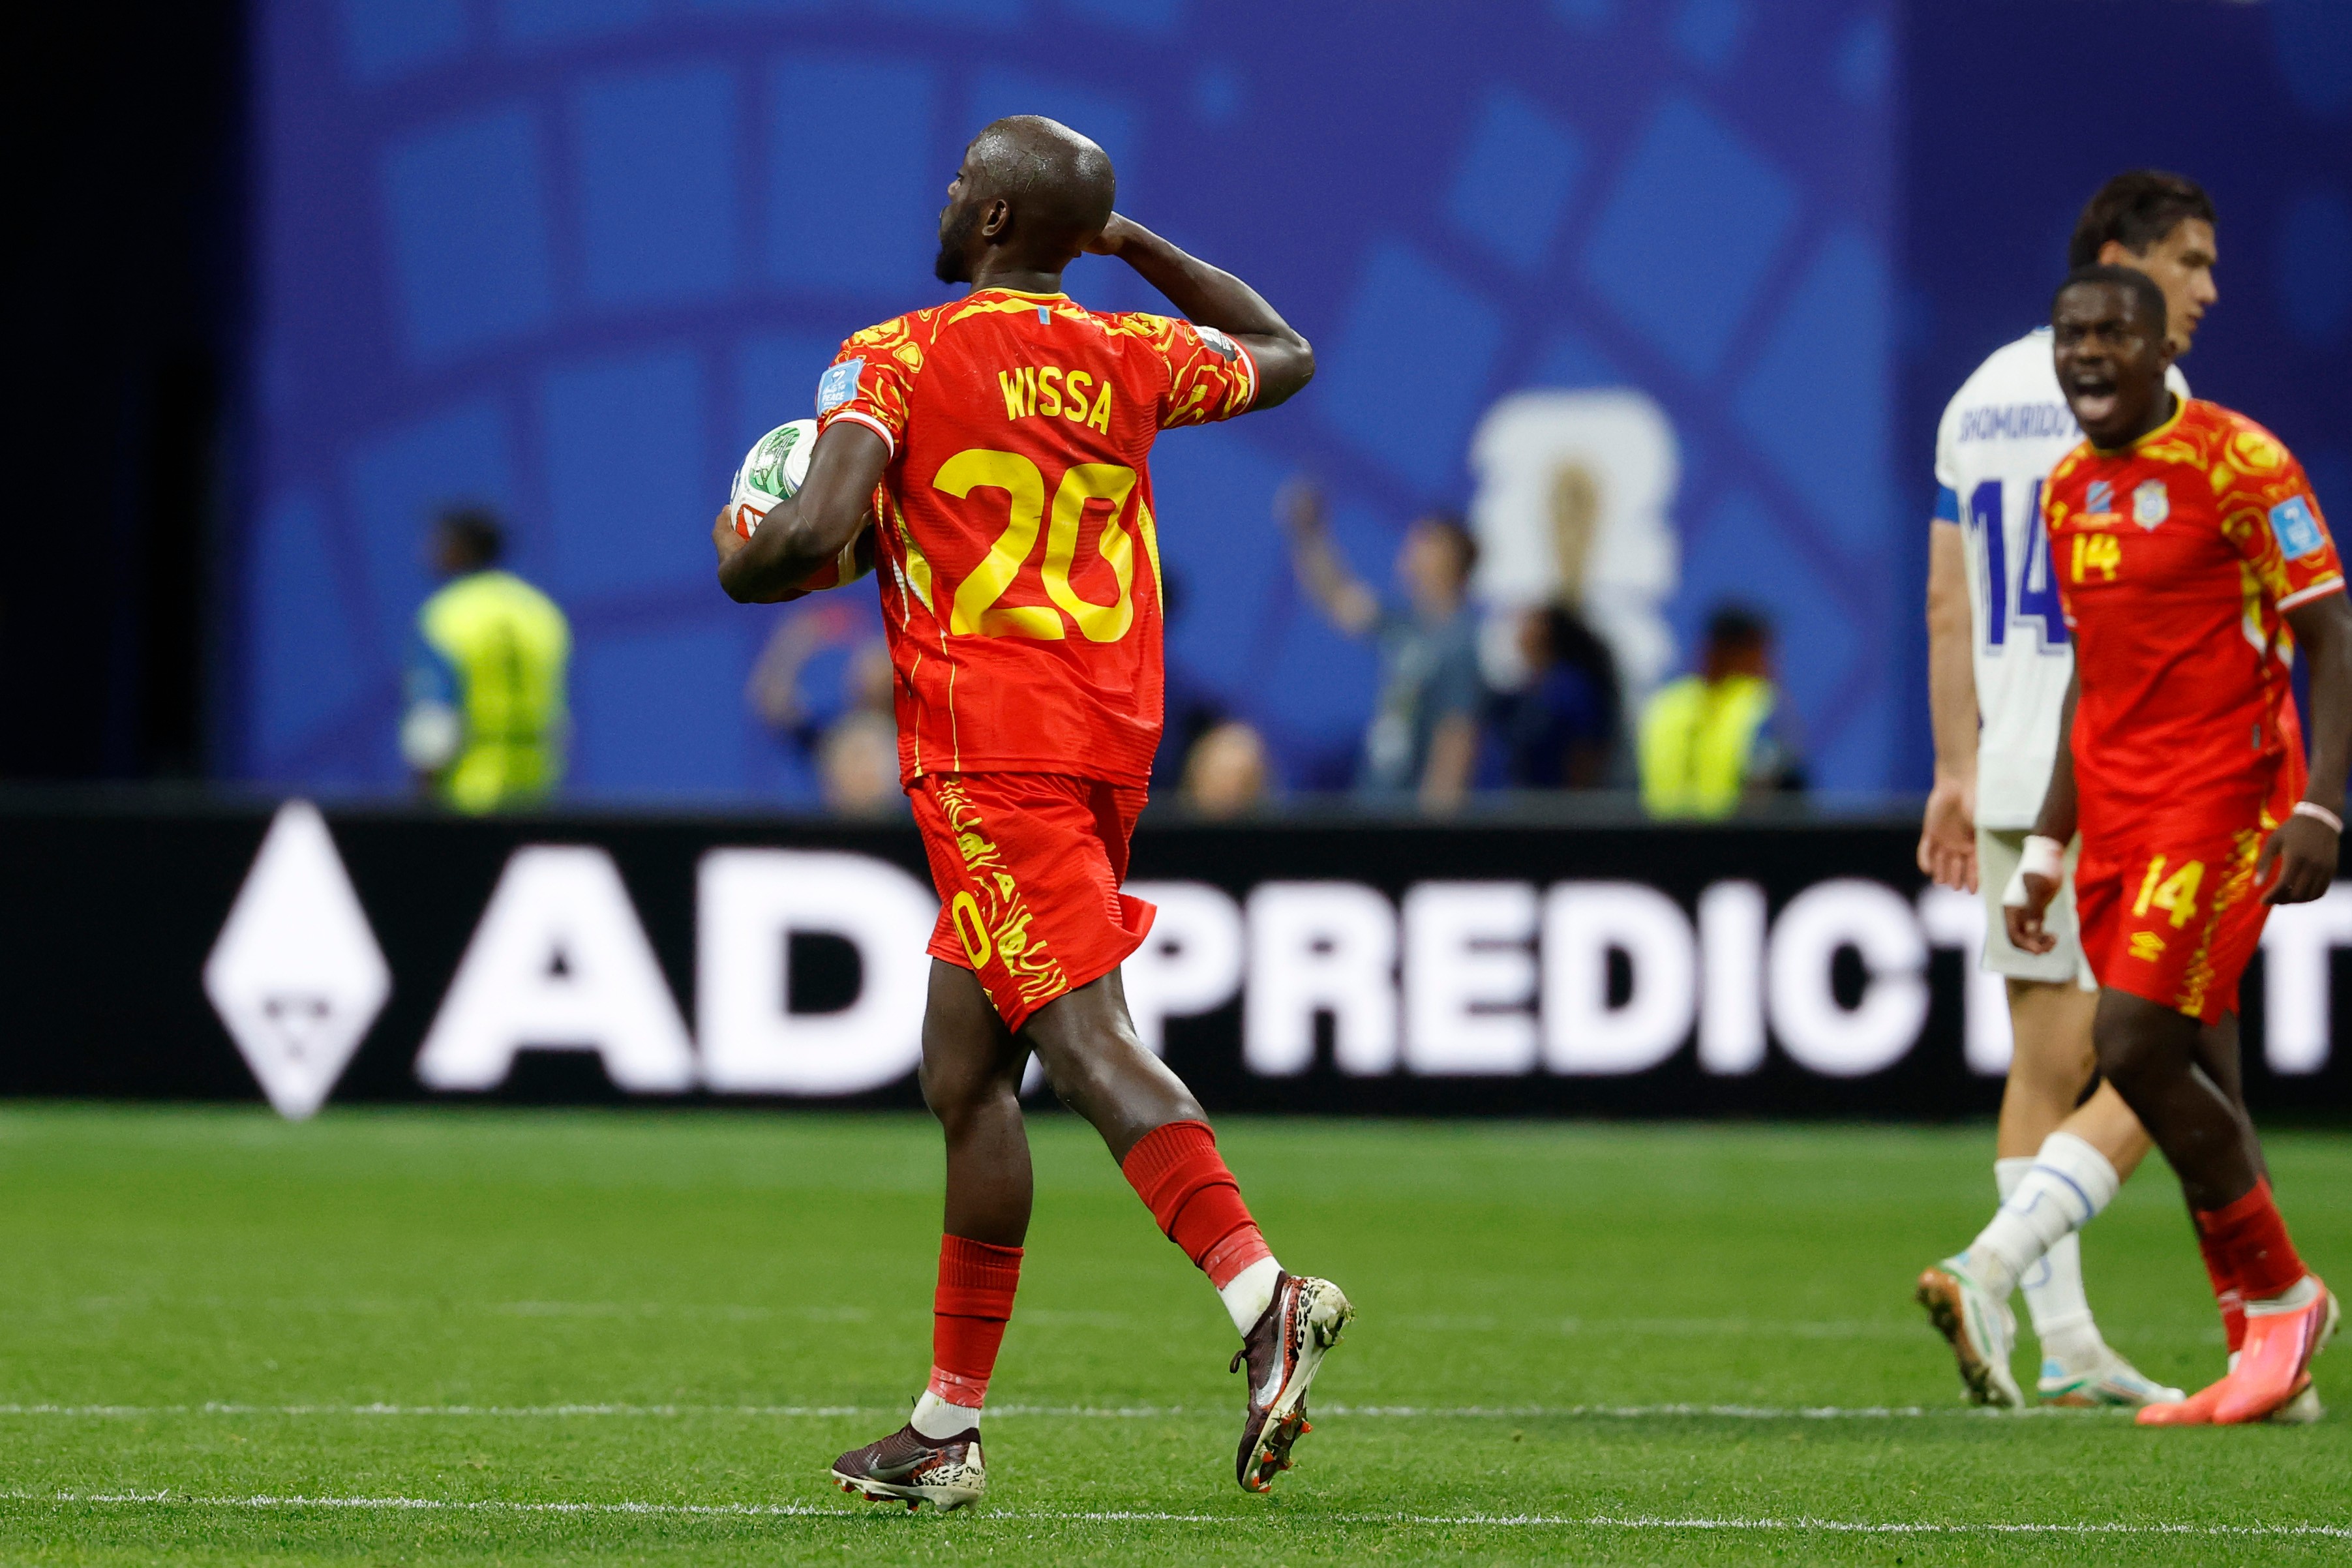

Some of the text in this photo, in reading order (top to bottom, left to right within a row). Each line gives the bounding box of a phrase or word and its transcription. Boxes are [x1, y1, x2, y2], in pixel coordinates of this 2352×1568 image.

[822, 391, 845, 403] PEACE
[999, 367, 1111, 435] WISSA
[934, 449, 1136, 644] 20
[2072, 533, 2121, 582] 14
[2132, 854, 2205, 928] 14
[415, 845, 1046, 1094] AD
